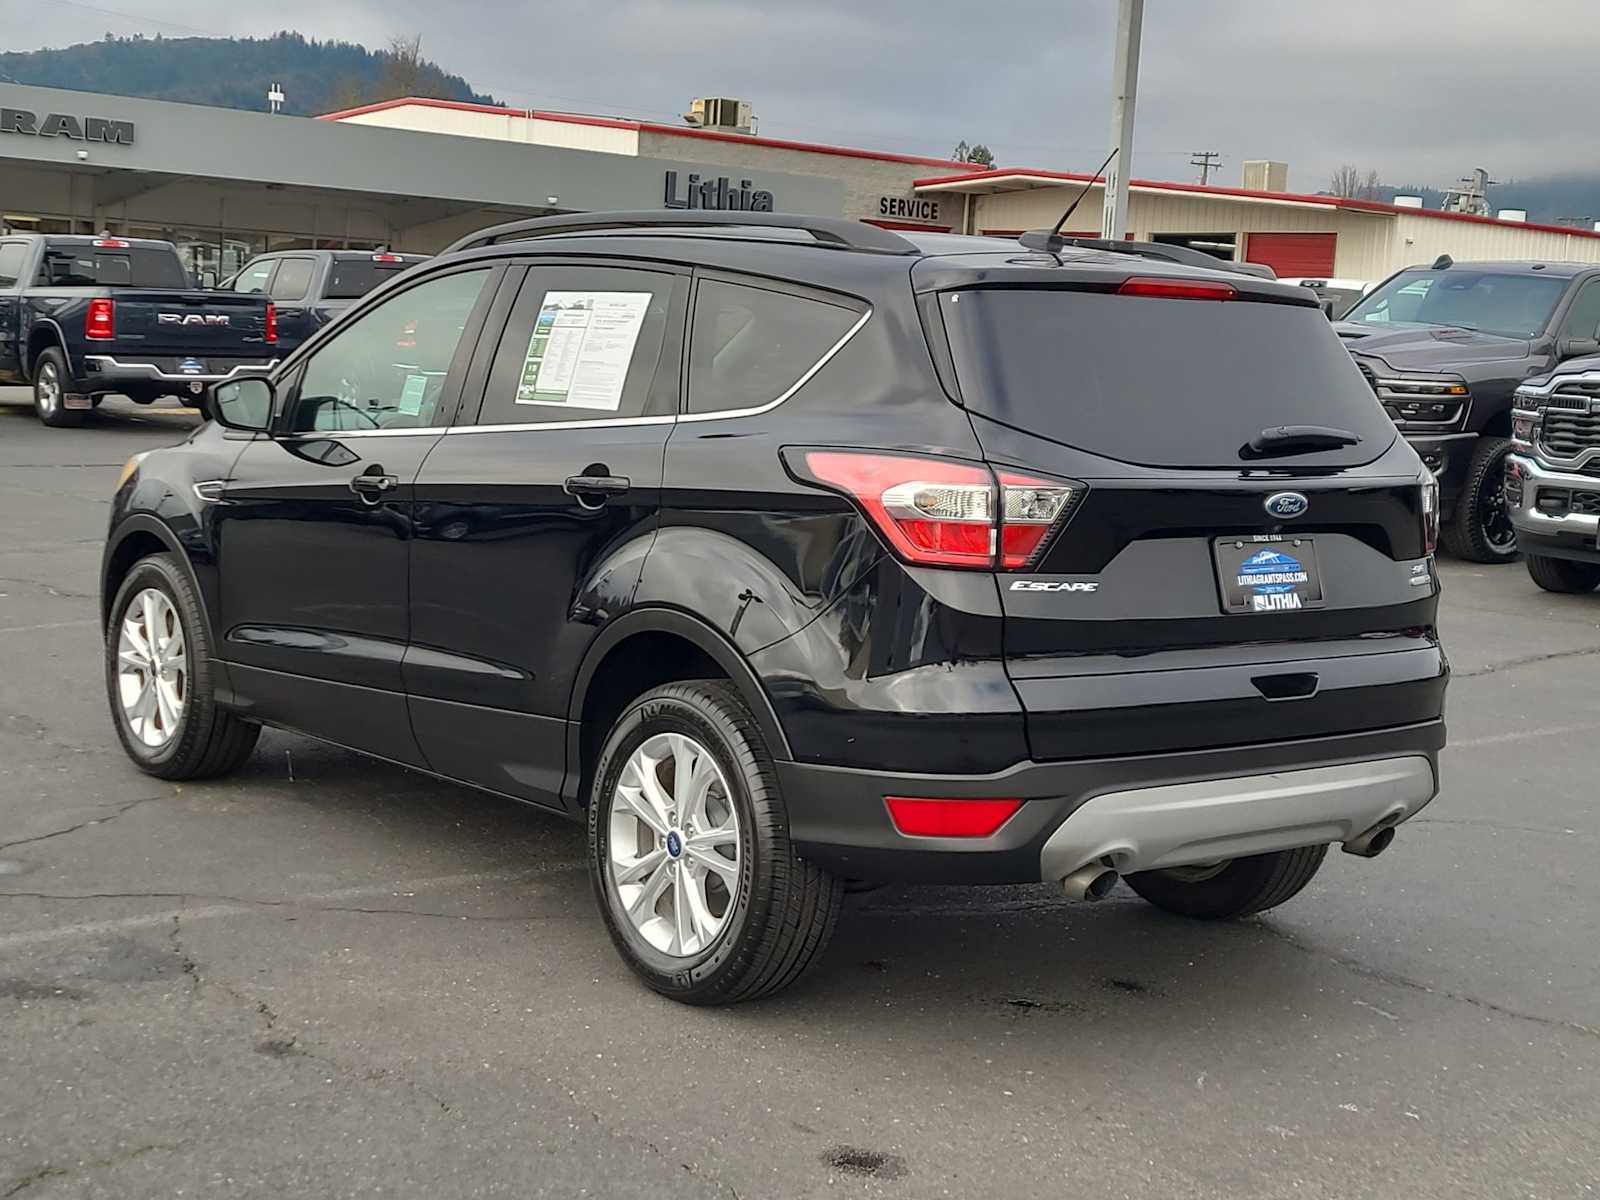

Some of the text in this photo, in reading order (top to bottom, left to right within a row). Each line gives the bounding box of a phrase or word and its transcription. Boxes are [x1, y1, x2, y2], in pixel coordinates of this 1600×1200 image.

[0, 108, 134, 144] RAM
[665, 170, 774, 212] Lithia
[880, 197, 938, 220] SERVICE
[158, 313, 230, 325] RAM
[1276, 497, 1301, 513] Ford
[1009, 580, 1099, 592] ESCAPE
[1265, 592, 1302, 610] LITHIA
